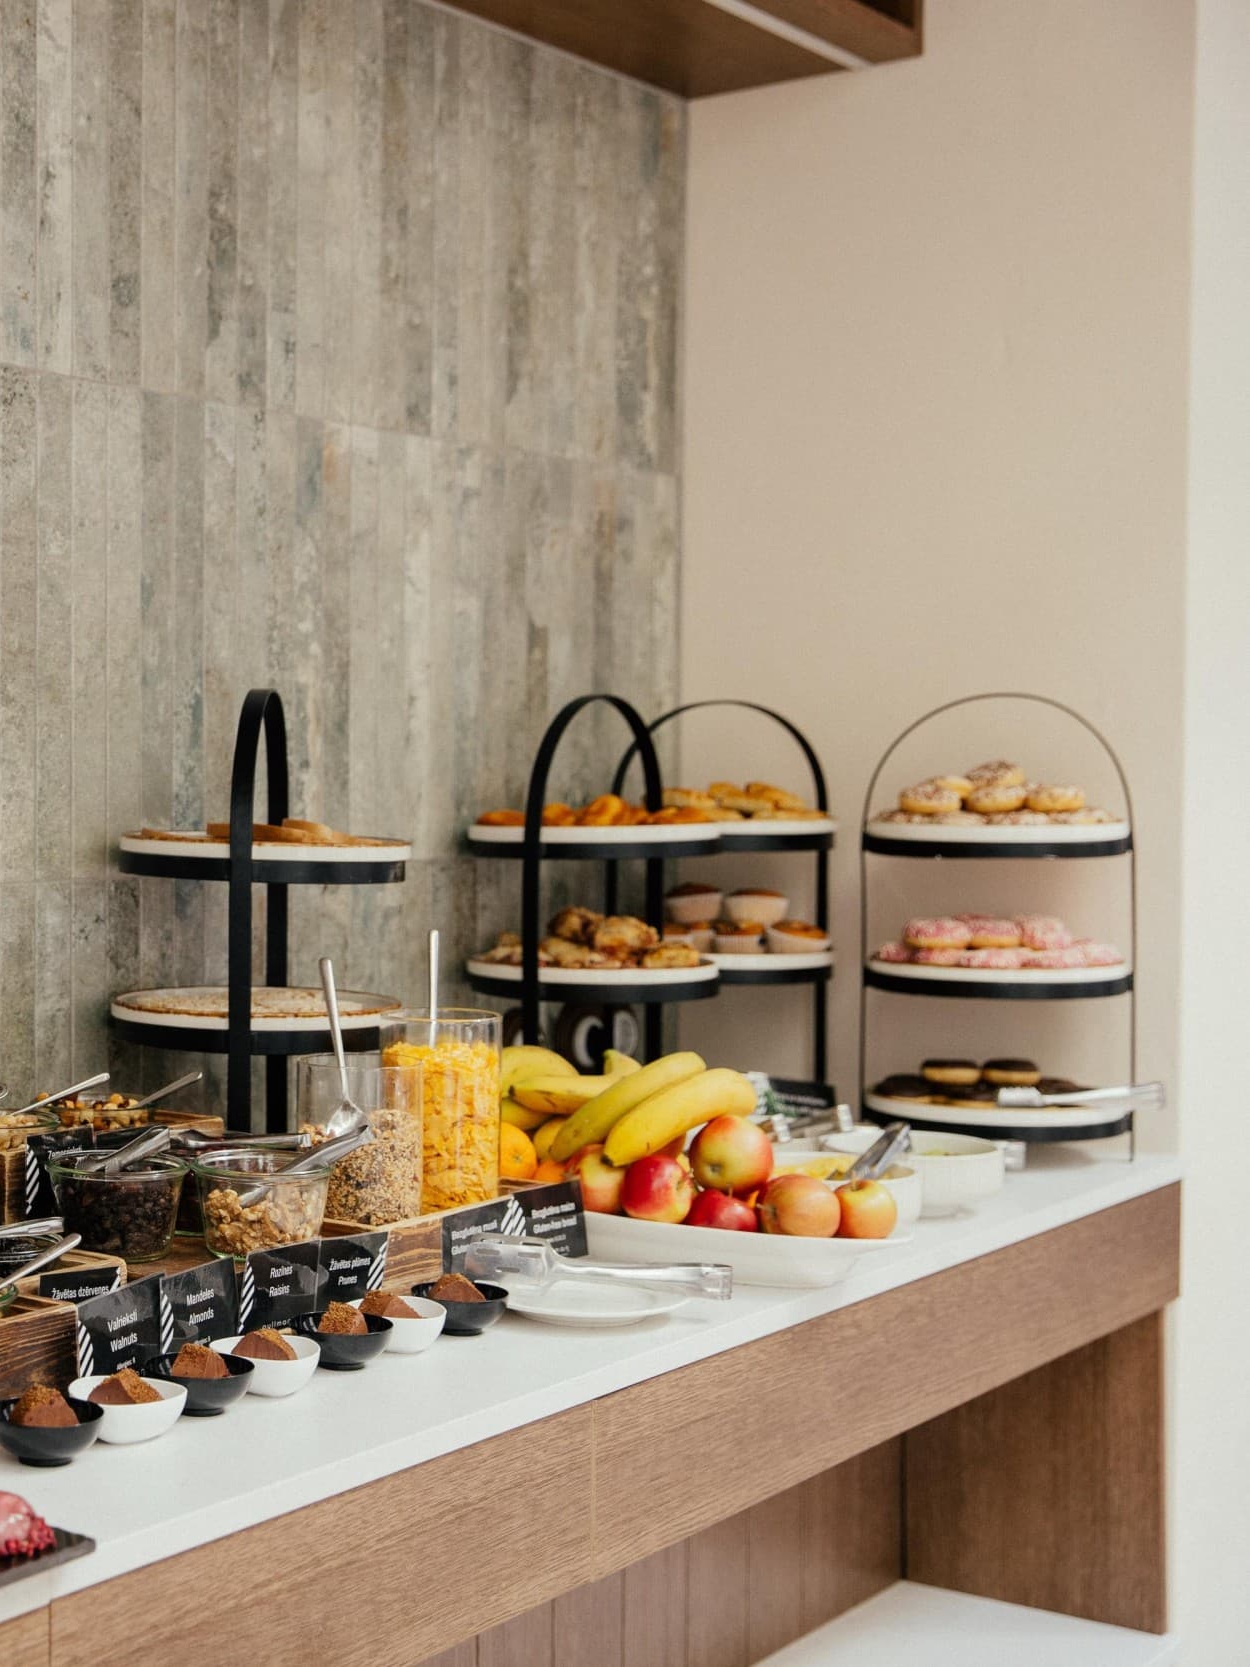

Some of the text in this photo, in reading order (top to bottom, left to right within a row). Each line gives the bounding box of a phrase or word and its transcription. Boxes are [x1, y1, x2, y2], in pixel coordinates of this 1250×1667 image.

[269, 1283, 290, 1297] Raisins
[338, 1275, 358, 1286] Prunes
[51, 1285, 110, 1300] Žāvētas dzērvenes
[186, 1287, 215, 1307] Mandeles
[107, 1308, 138, 1333] Valrieksti
[189, 1306, 215, 1326] Almonds
[110, 1332, 138, 1353] Walnuts
